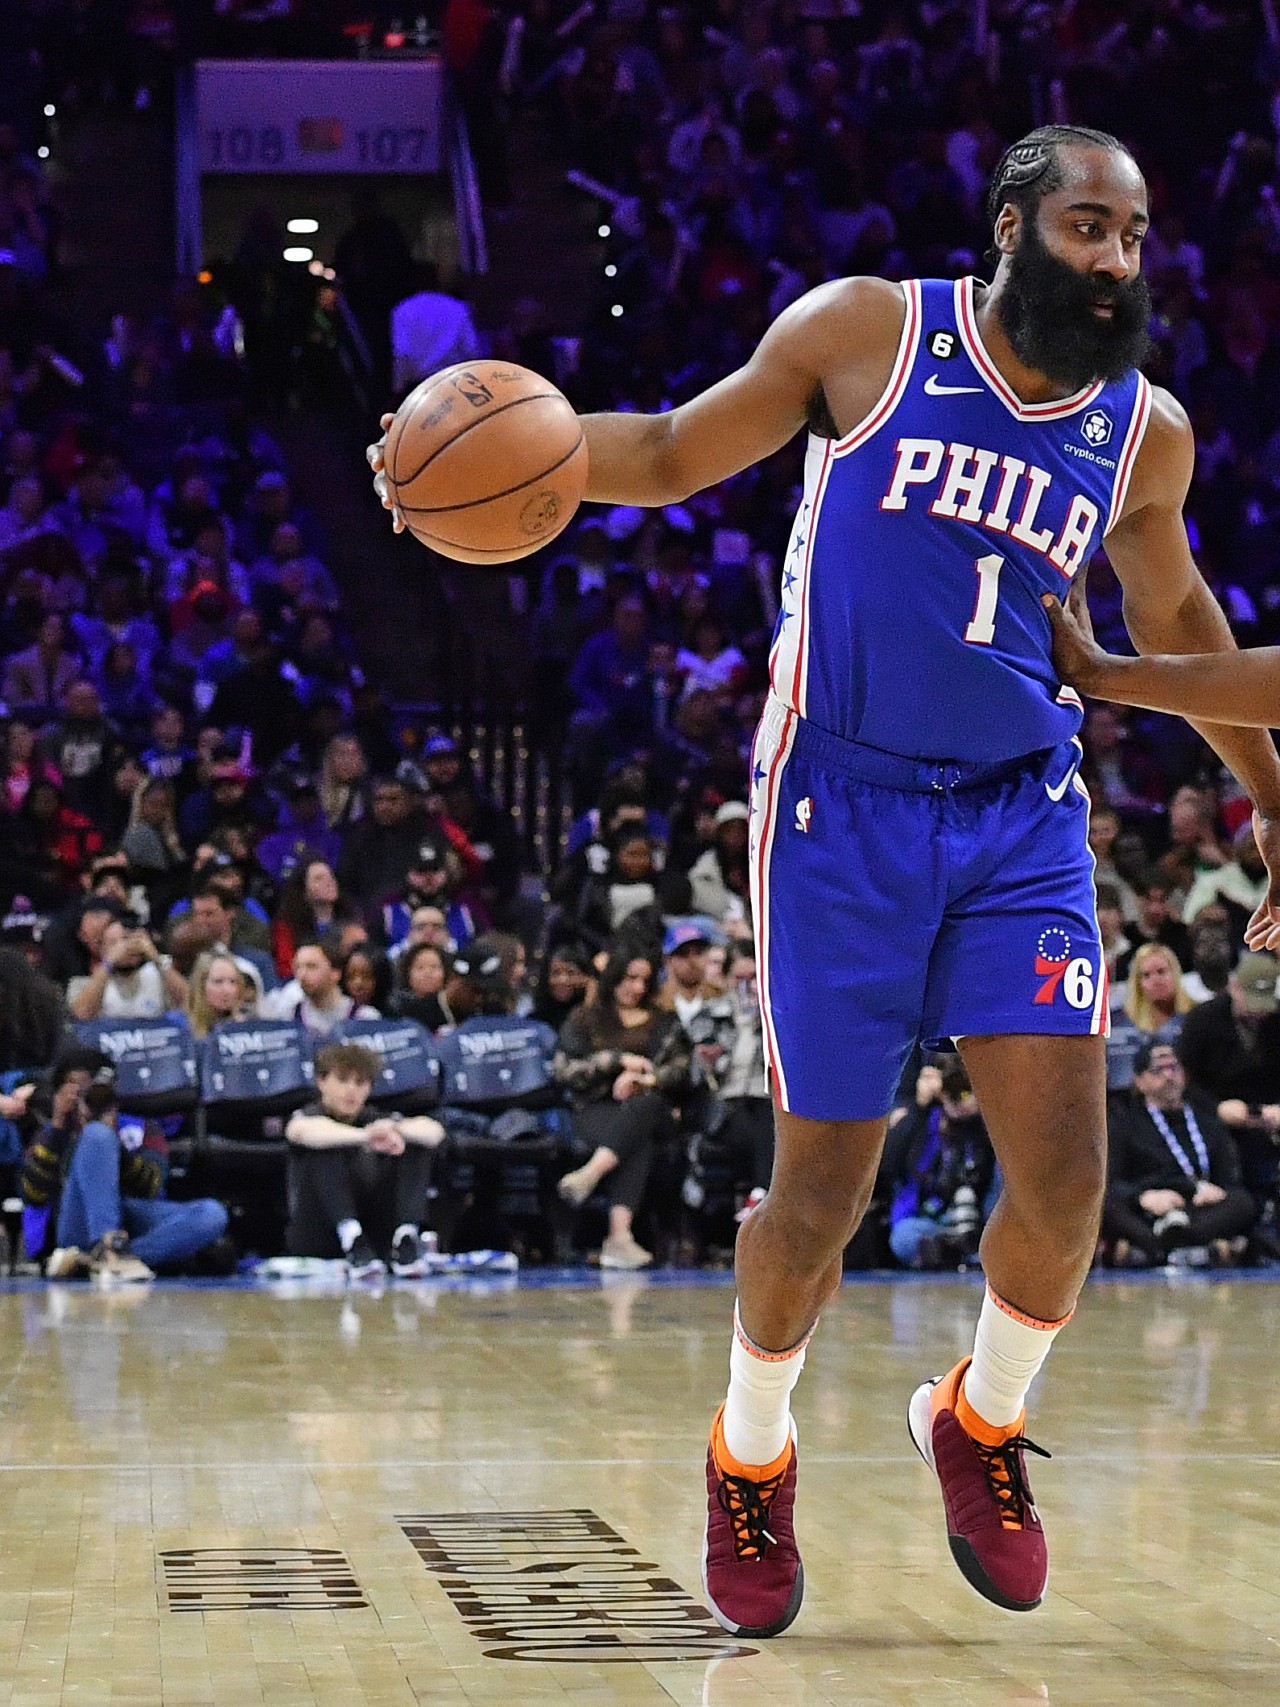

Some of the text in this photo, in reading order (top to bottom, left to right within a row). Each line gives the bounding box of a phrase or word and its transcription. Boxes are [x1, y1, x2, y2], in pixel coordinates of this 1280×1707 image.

[356, 127, 427, 165] 107
[931, 333, 955, 358] 6
[1063, 443, 1116, 470] crypto.com
[879, 438, 1099, 579] PHILA
[964, 553, 1005, 645] 1
[1034, 955, 1094, 1009] 76
[158, 1548, 370, 1613] CENTER
[393, 1508, 762, 1662] WELLS FARGO
